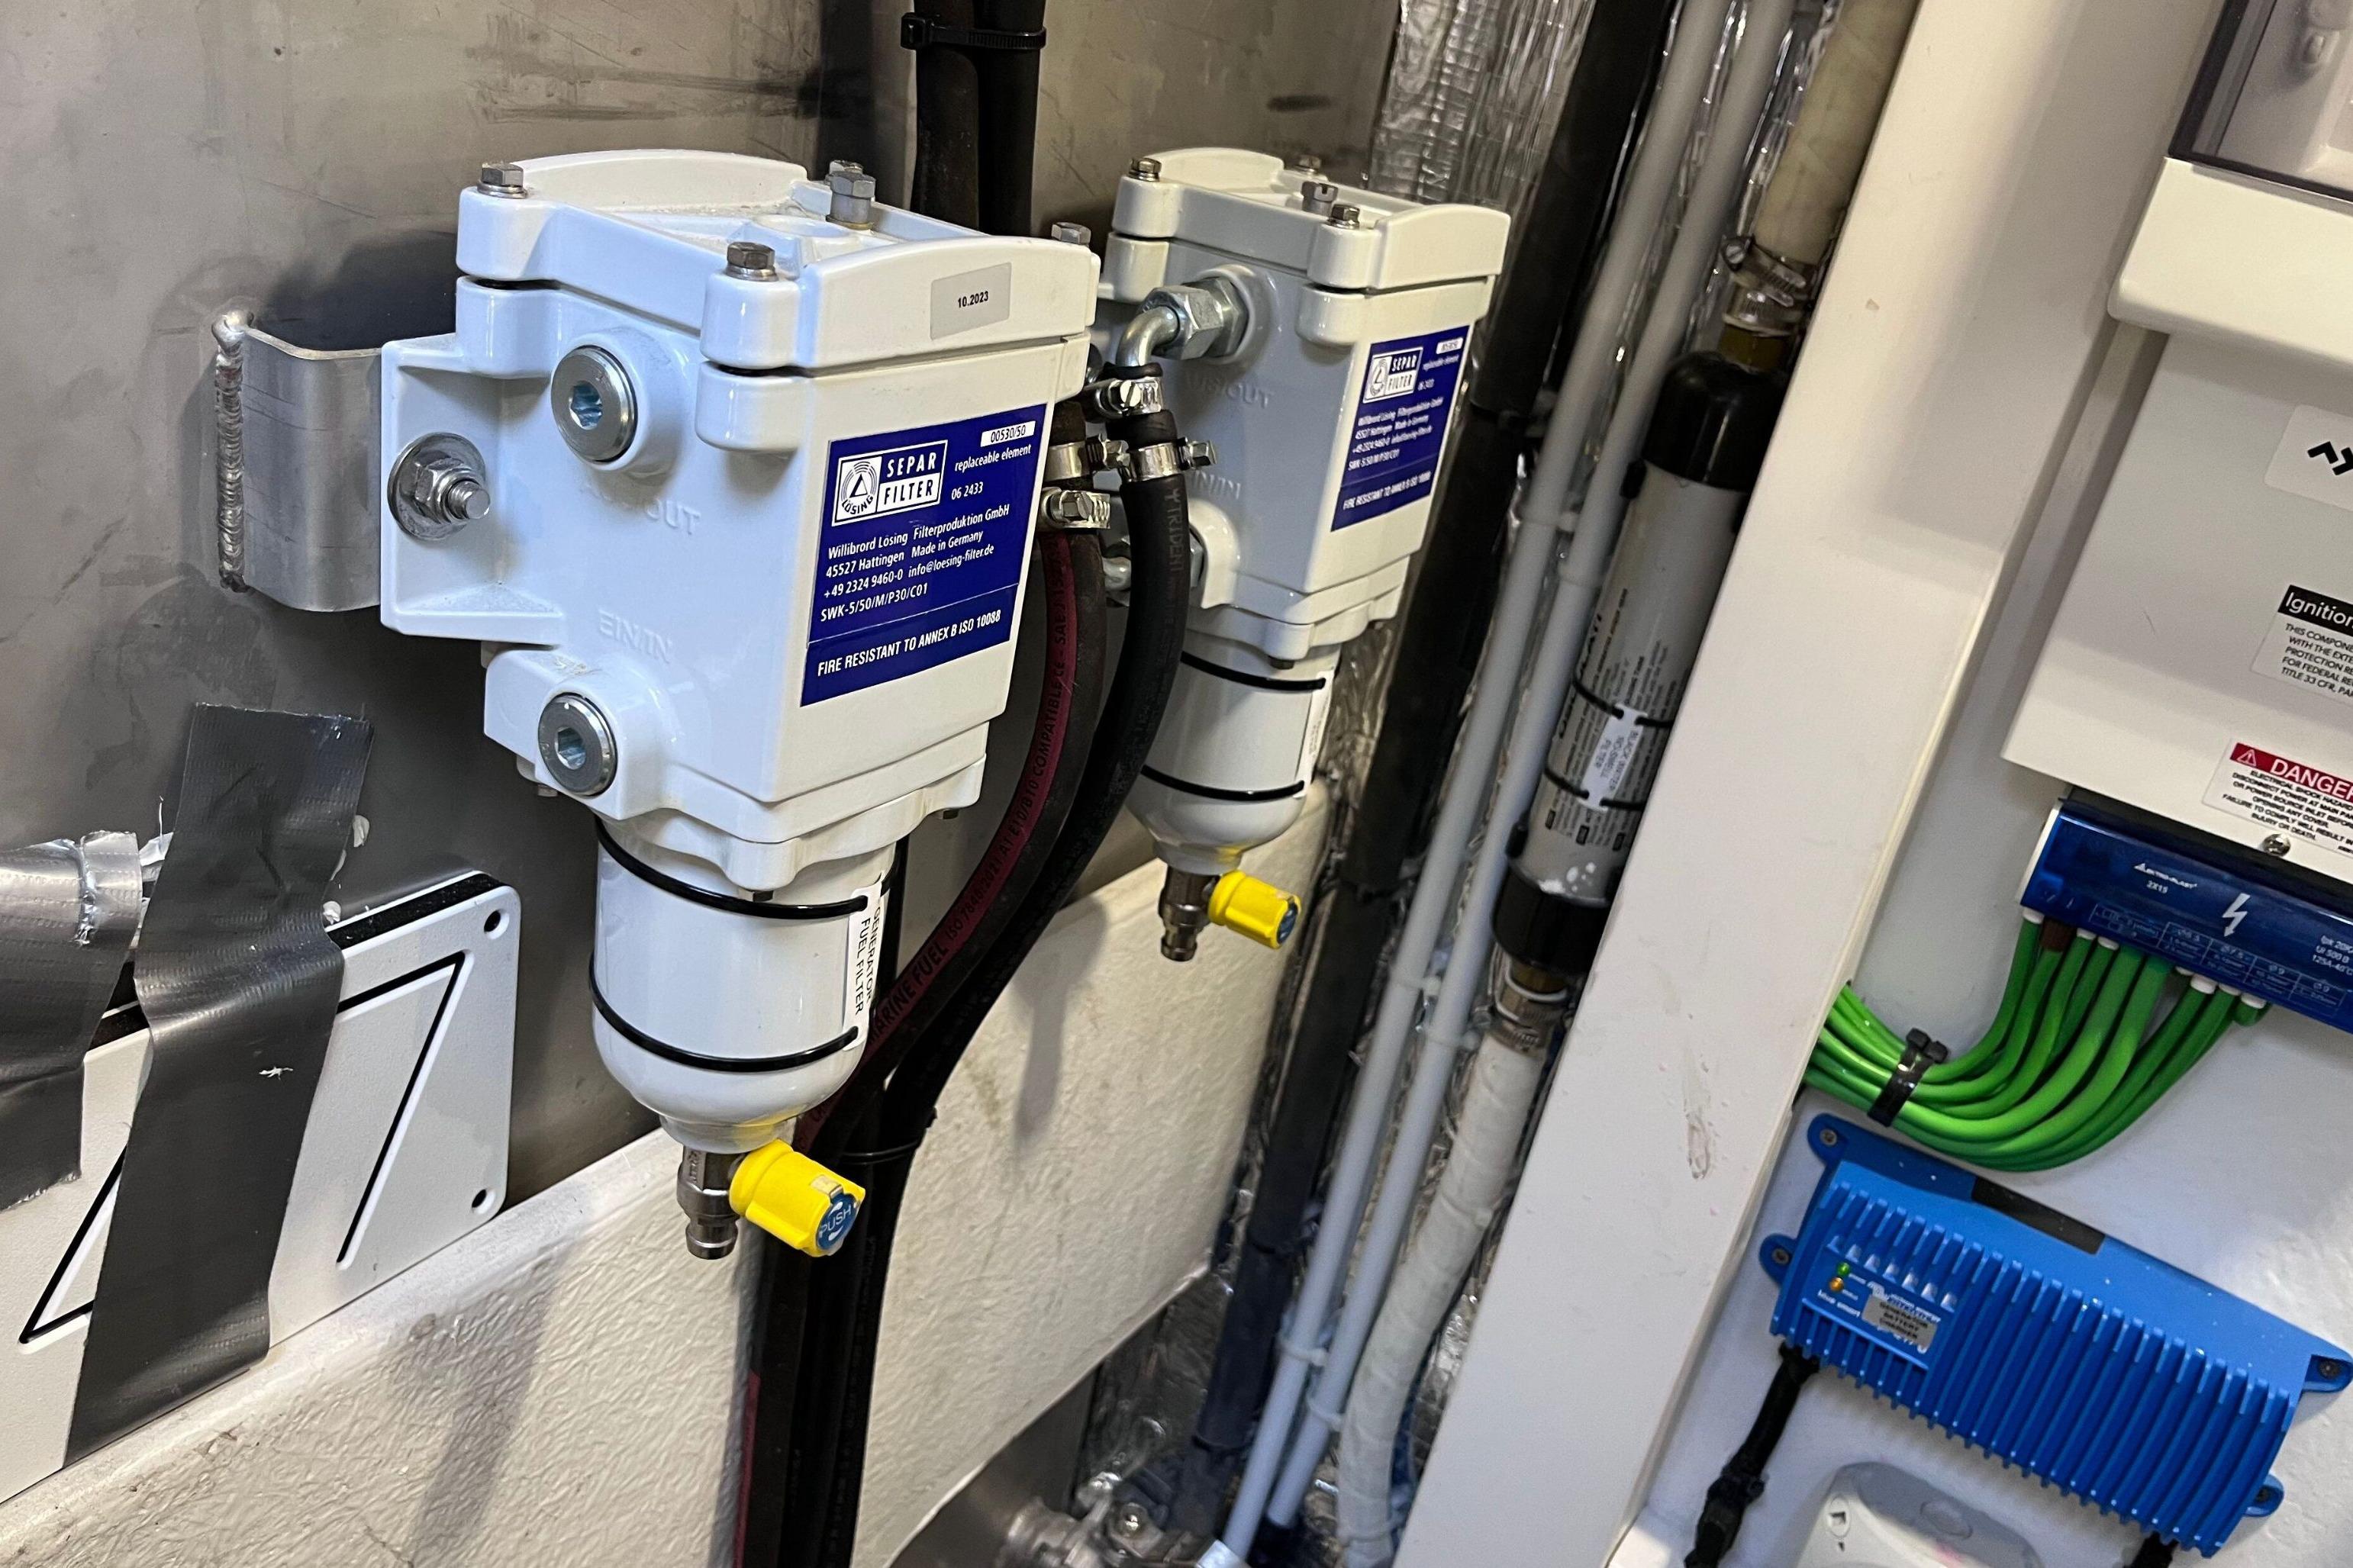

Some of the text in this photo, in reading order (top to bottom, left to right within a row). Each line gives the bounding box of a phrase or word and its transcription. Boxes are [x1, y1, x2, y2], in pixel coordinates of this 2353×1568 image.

[957, 291, 989, 308] 10.2023
[1391, 355, 1417, 372] SEPAR
[990, 424, 1027, 443] 00530/50
[886, 452, 937, 478] SEPAR
[954, 443, 1032, 473] replaceable element
[883, 479, 933, 505] FILTER
[951, 481, 984, 500] 06 2433
[841, 494, 875, 515] LÖSING
[828, 536, 876, 559] Willibrord
[913, 514, 983, 539] Filterproduktion
[985, 504, 1010, 520] GmbH
[826, 530, 983, 578] 45527 Hattingen Made in Germany
[824, 543, 994, 598] +49 2324 9460-0 info@loesing-filter.de
[820, 582, 928, 622] SWK-5/50/M/P30/C01
[817, 610, 1001, 677] FIRE RESISTANT TO ANNEX B ISO 10088
[2282, 656, 2302, 668] FOR
[2303, 662, 2340, 682] FEDERAL
[2285, 646, 2344, 671] PROTECTION
[2222, 794, 2252, 809] FAILURE
[2255, 803, 2264, 813] TO
[2245, 784, 2273, 799] POWER
[2280, 789, 2307, 803] POWER
[914, 943, 949, 987] FUEL
[1033, 680, 1064, 778] COMPATIBLE
[857, 916, 872, 959] FUEL
[855, 959, 865, 1016] FILTER
[818, 1204, 853, 1239] PUSH
